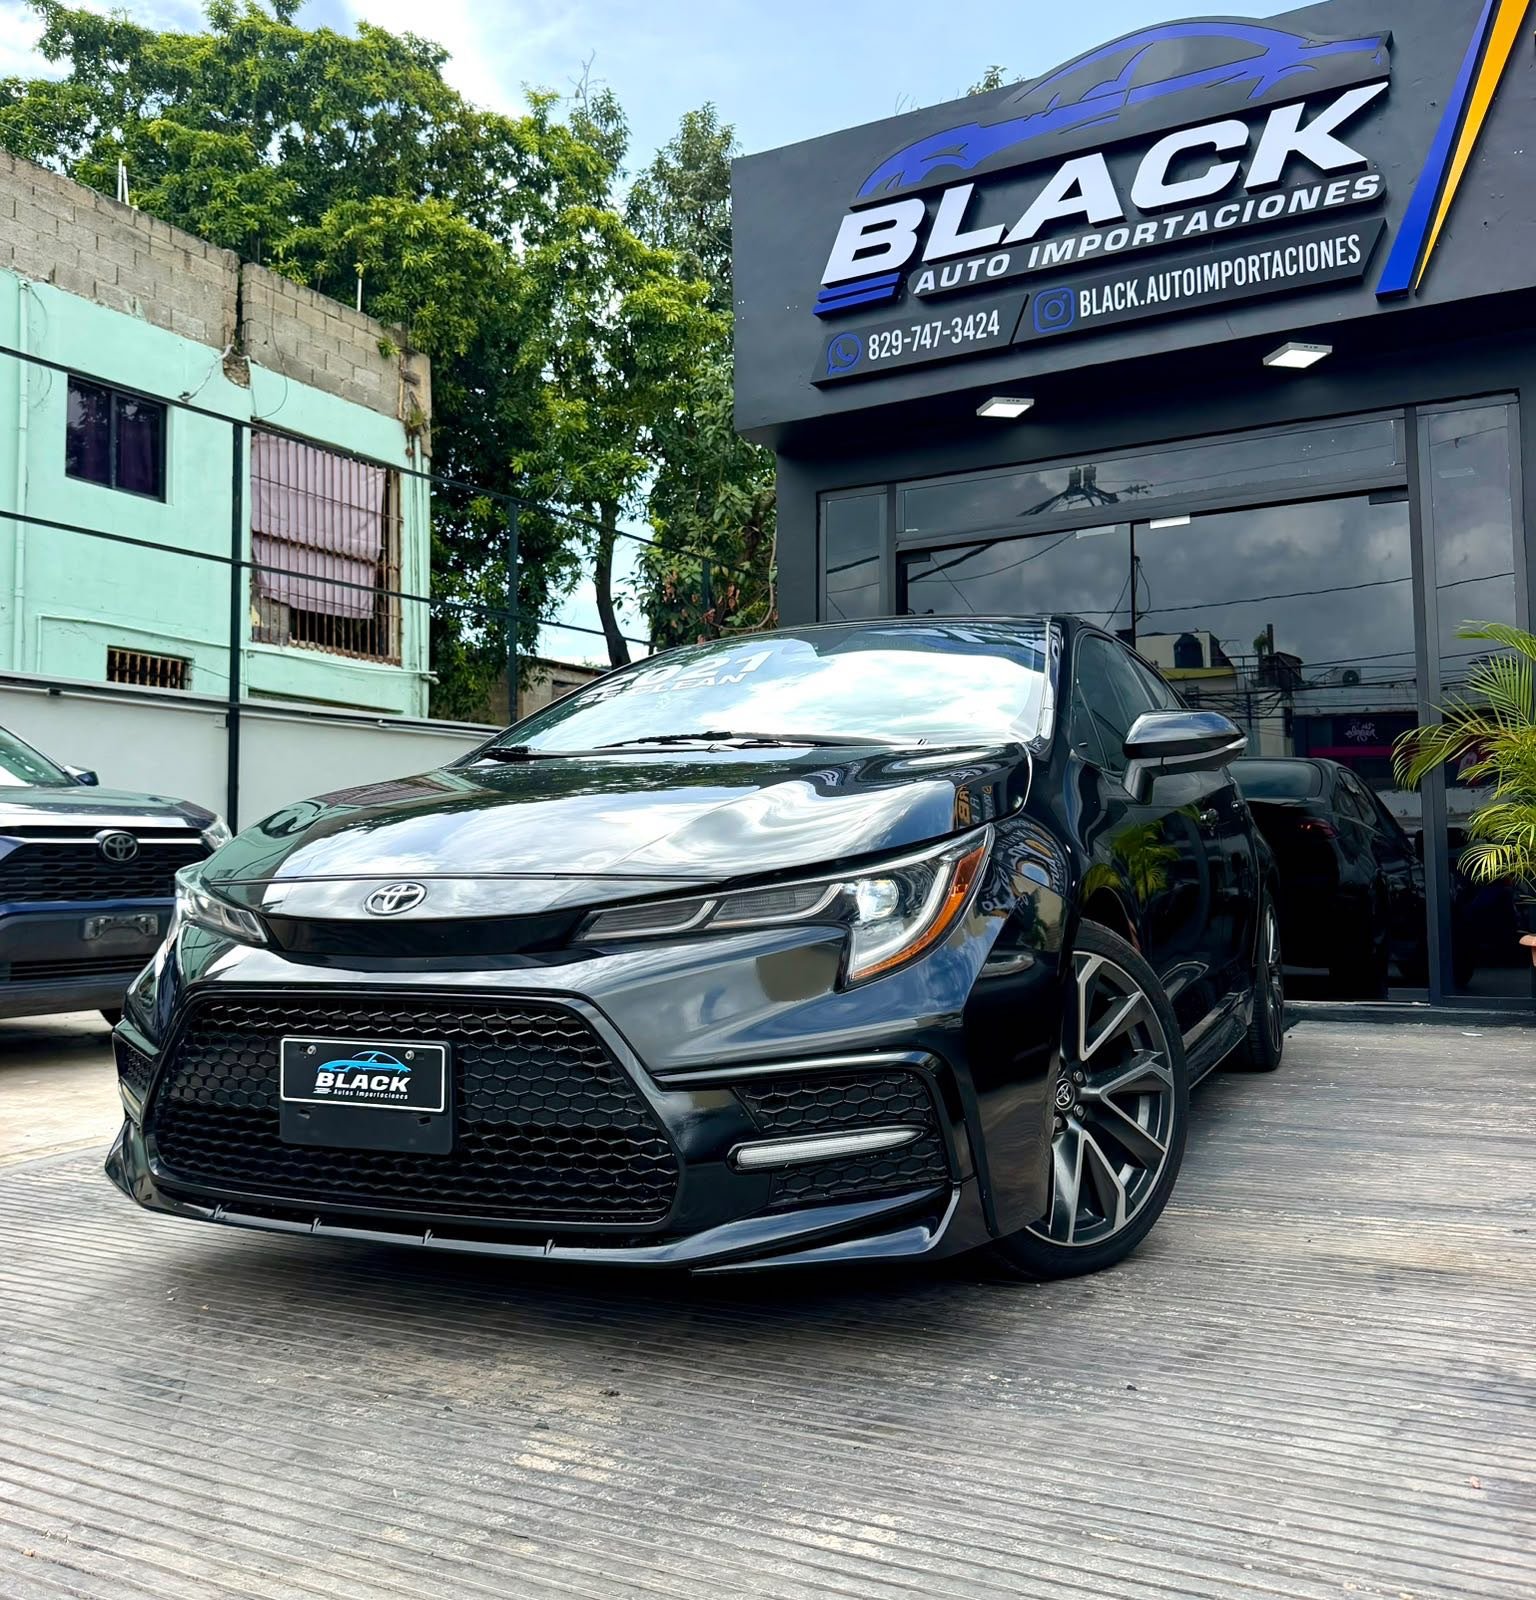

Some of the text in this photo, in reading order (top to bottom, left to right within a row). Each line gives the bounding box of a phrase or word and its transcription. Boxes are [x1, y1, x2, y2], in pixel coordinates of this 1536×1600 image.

[820, 82, 1388, 286] BLACK
[913, 173, 1381, 294] AUTO IMPORTACIONES
[1079, 233, 1362, 318] BLACK.AUTOIMPORTACIONES
[867, 309, 1001, 361] 829-747-3424
[579, 650, 775, 698] 2021
[628, 672, 748, 697] CLEAN
[315, 1072, 411, 1092] BLACK
